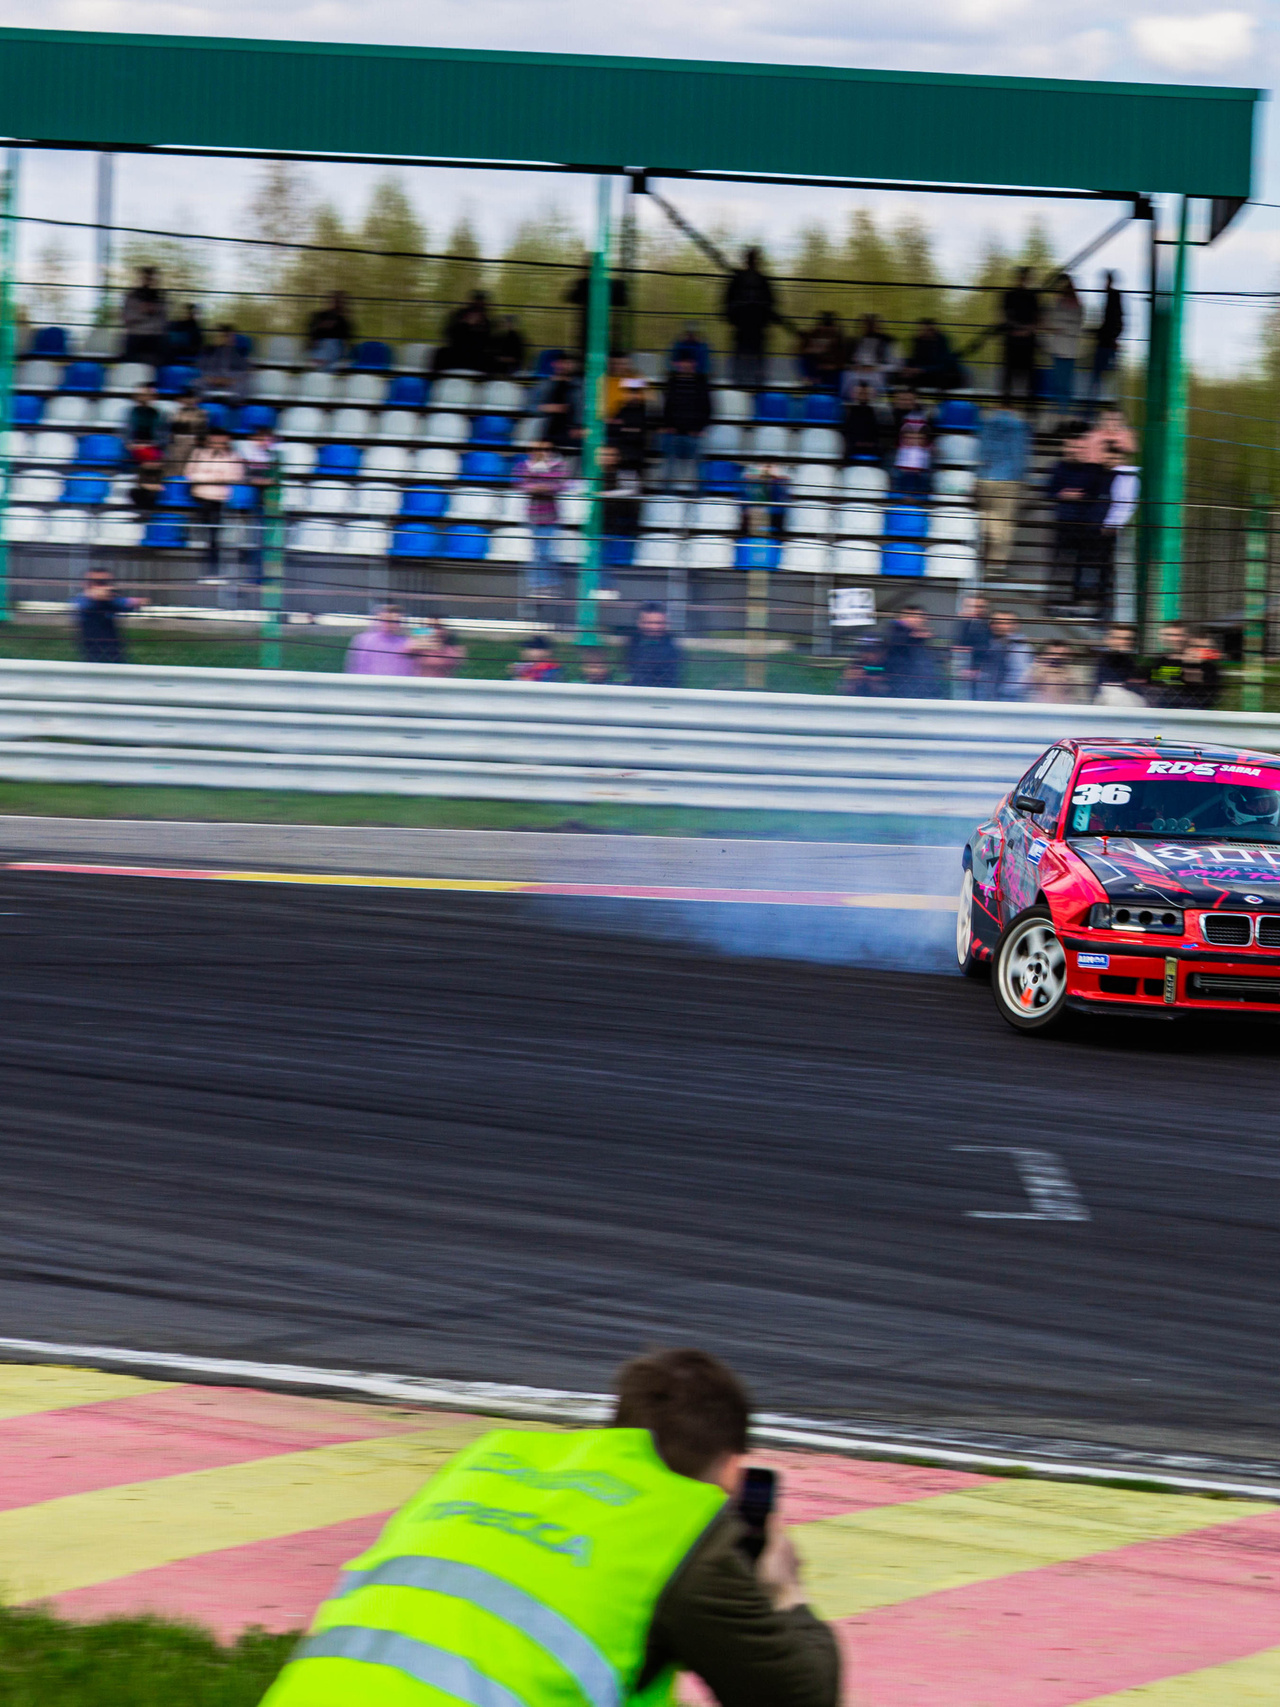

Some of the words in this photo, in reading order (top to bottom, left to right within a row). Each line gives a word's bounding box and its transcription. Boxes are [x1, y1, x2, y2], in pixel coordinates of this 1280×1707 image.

[1146, 760, 1221, 776] RDS
[1219, 764, 1262, 776] ЗАПАД
[1071, 783, 1132, 805] 36
[1177, 868, 1240, 879] Drift
